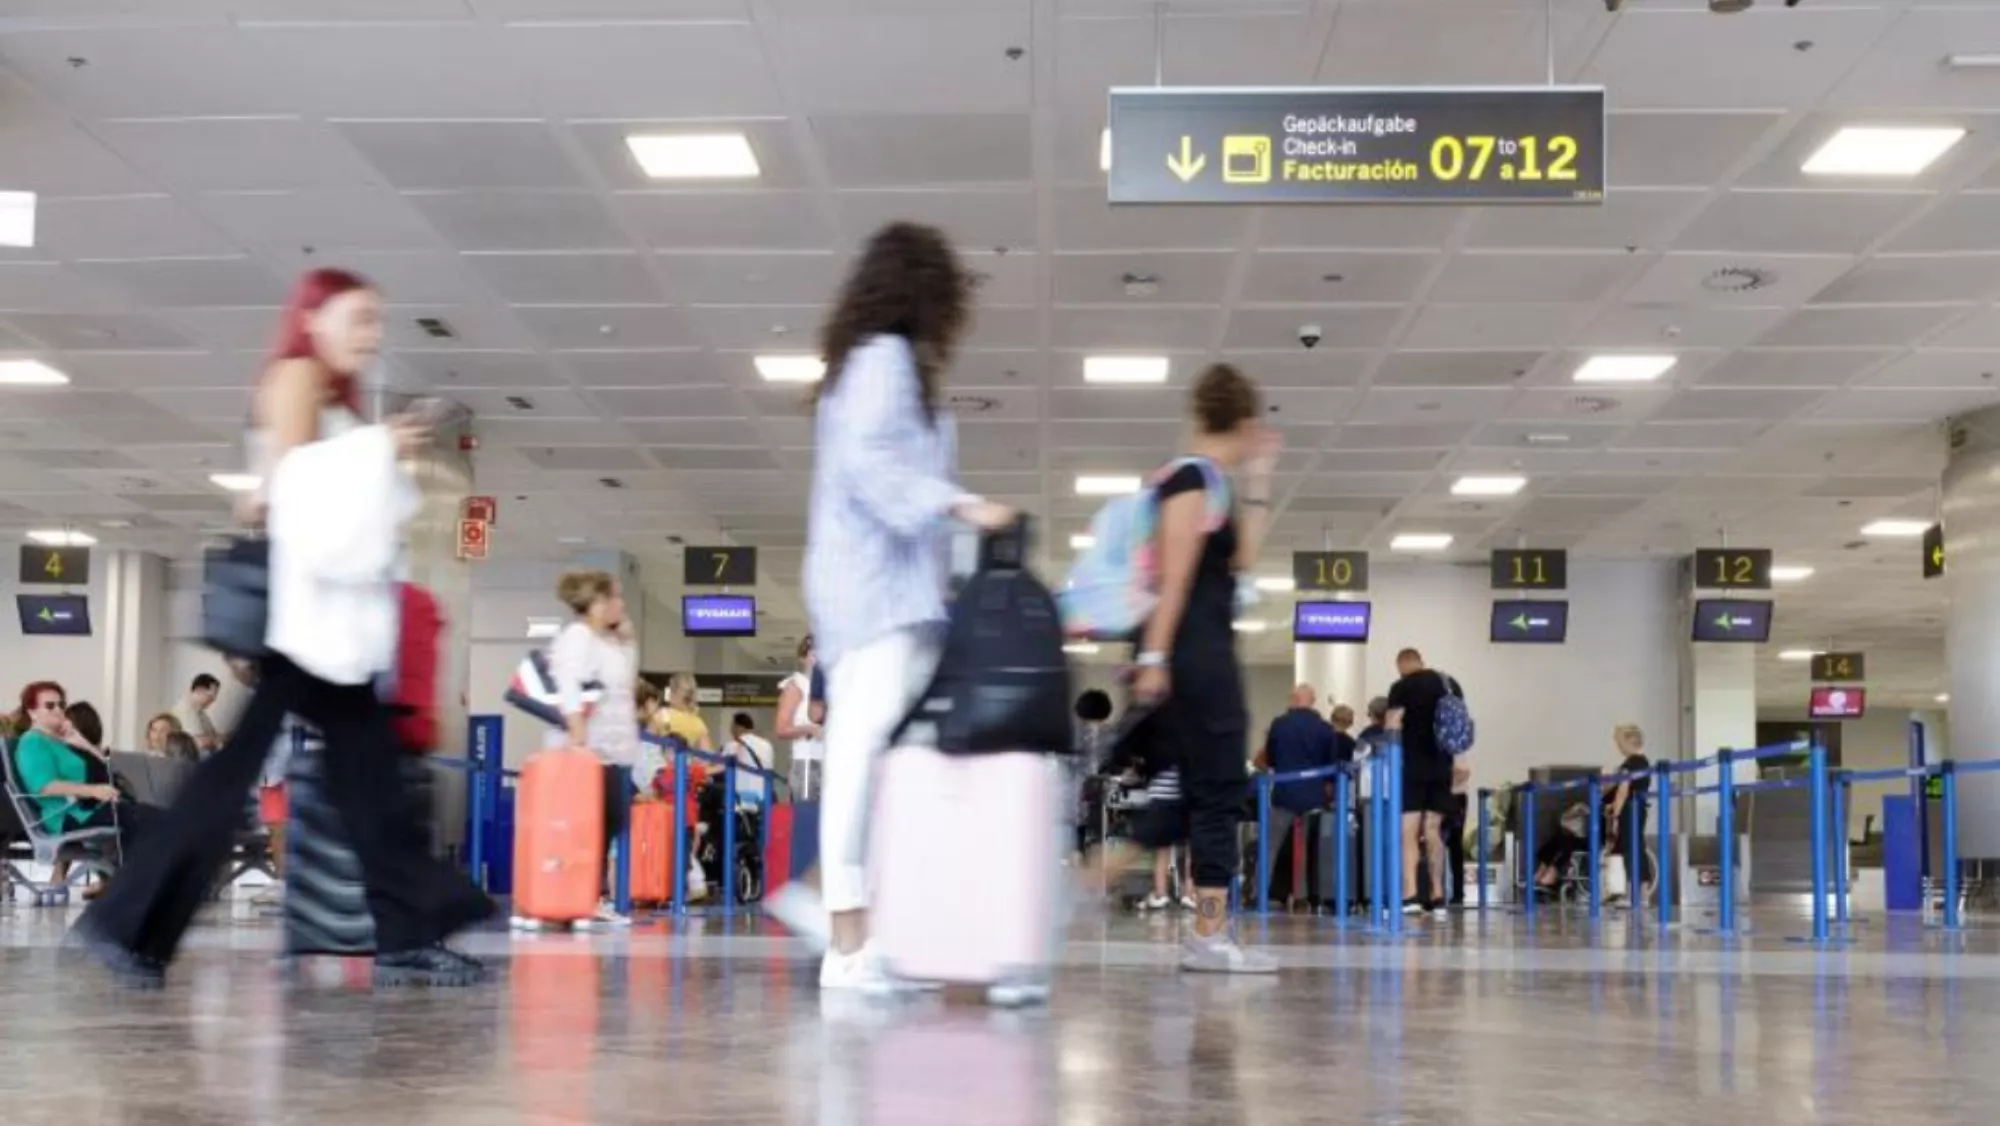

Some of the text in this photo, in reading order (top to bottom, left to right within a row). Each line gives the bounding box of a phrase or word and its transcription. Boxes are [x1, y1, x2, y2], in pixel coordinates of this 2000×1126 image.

[1283, 113, 1417, 137] Gepäckaufgabe
[1283, 137, 1357, 156] Check-in
[1430, 136, 1577, 181] 07 to 12
[1283, 159, 1417, 180] Facturación
[1500, 163, 1515, 180] a
[45, 552, 63, 578] 4
[712, 553, 728, 578] 7
[1316, 559, 1351, 585] 10
[1514, 556, 1547, 582] 11
[1716, 556, 1752, 582] 12
[1825, 658, 1851, 676] 14
